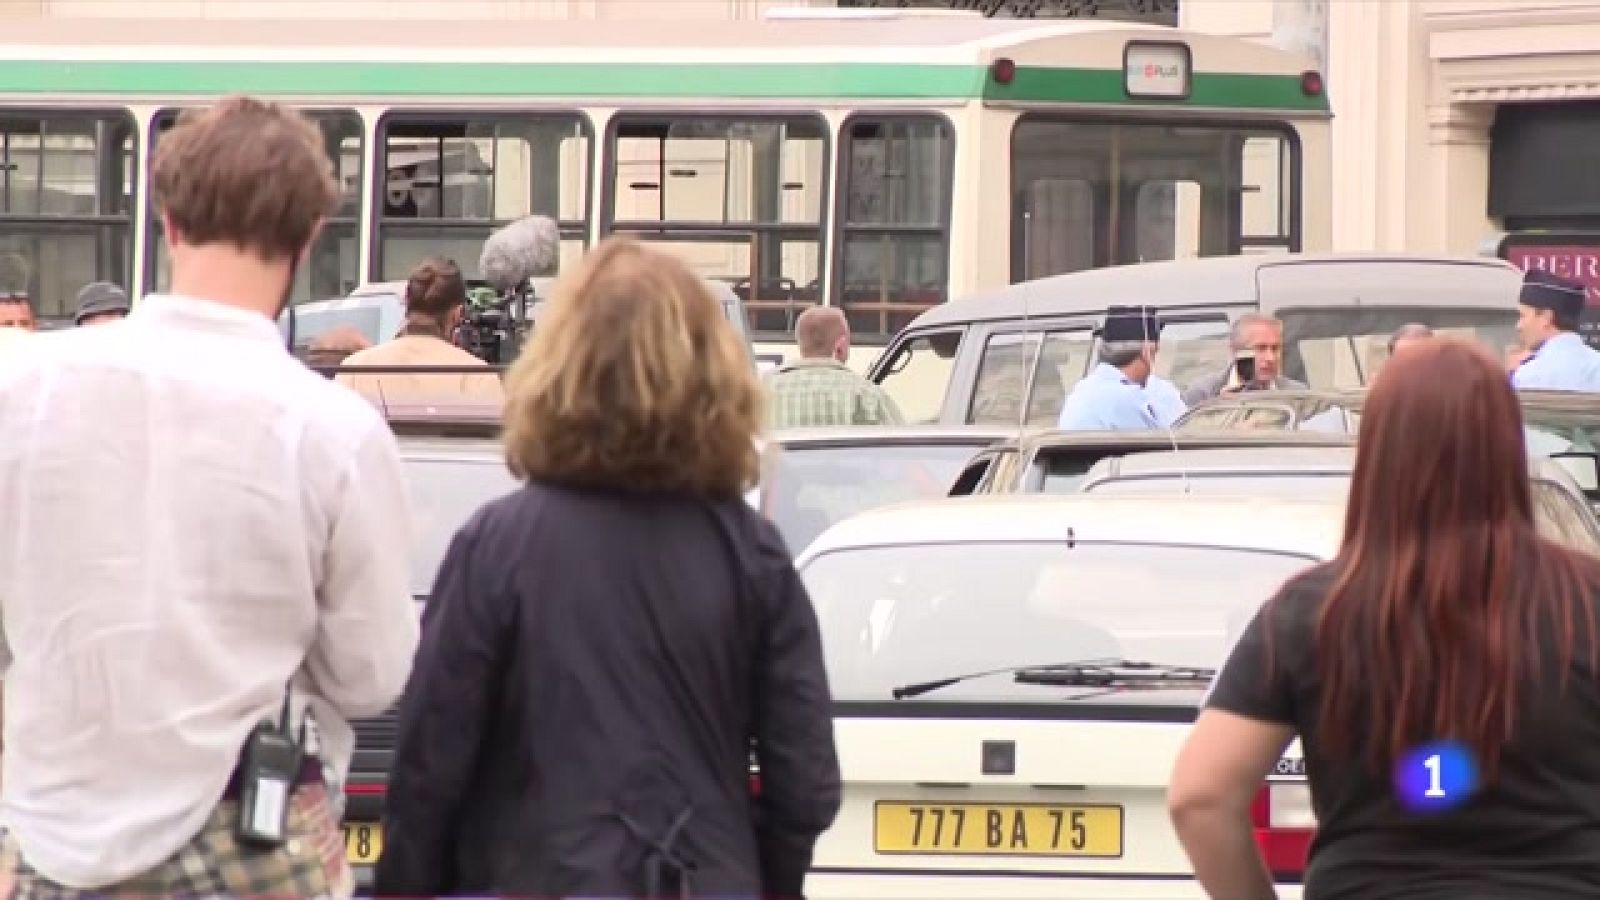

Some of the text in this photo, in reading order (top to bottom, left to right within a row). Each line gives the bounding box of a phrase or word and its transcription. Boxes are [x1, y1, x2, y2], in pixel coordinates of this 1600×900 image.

[909, 807, 1086, 850] 777 BA 75
